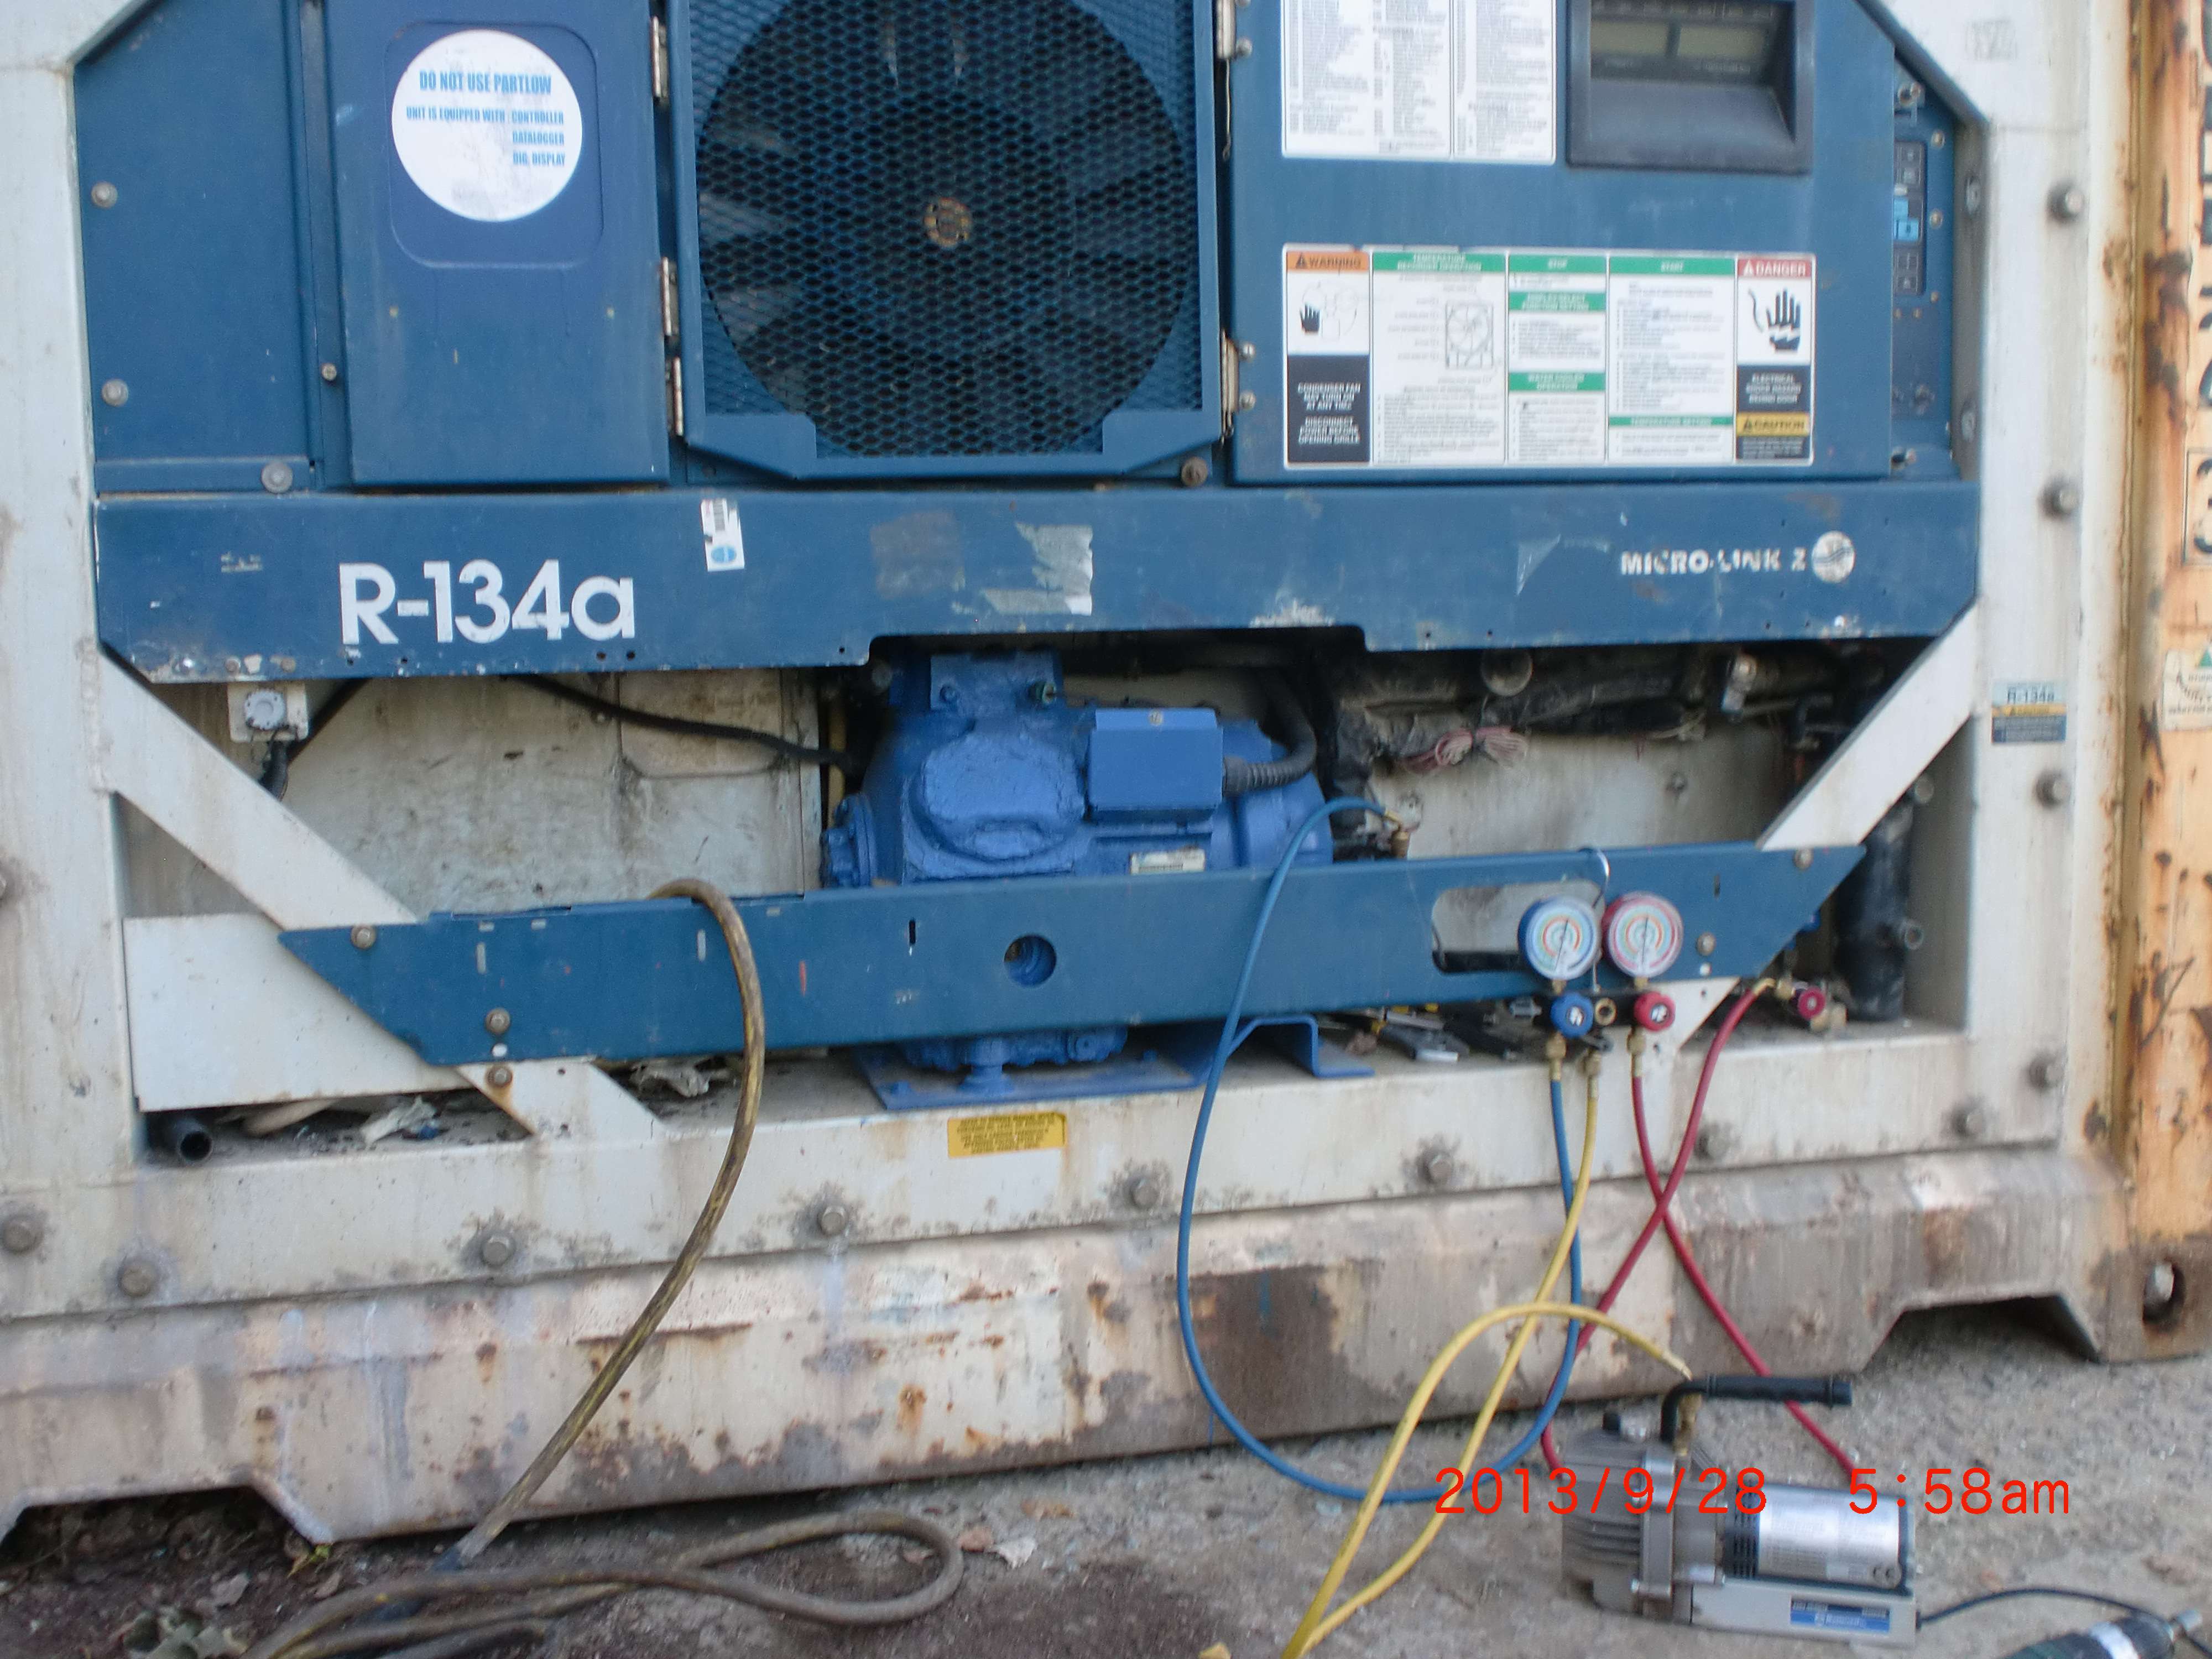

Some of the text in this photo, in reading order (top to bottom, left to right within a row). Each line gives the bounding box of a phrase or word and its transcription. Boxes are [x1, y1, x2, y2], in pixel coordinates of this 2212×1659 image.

[419, 70, 552, 95] DO NOT USE PARTLOW
[406, 106, 564, 125] UNIT IS EQUIPPED WITH CONTROLLER
[513, 131, 564, 146] DATALOGGER
[532, 153, 565, 166] DISPLAY
[1310, 256, 1361, 269] WARNING
[1756, 262, 1806, 276] DANGER
[338, 559, 636, 646] R-134a
